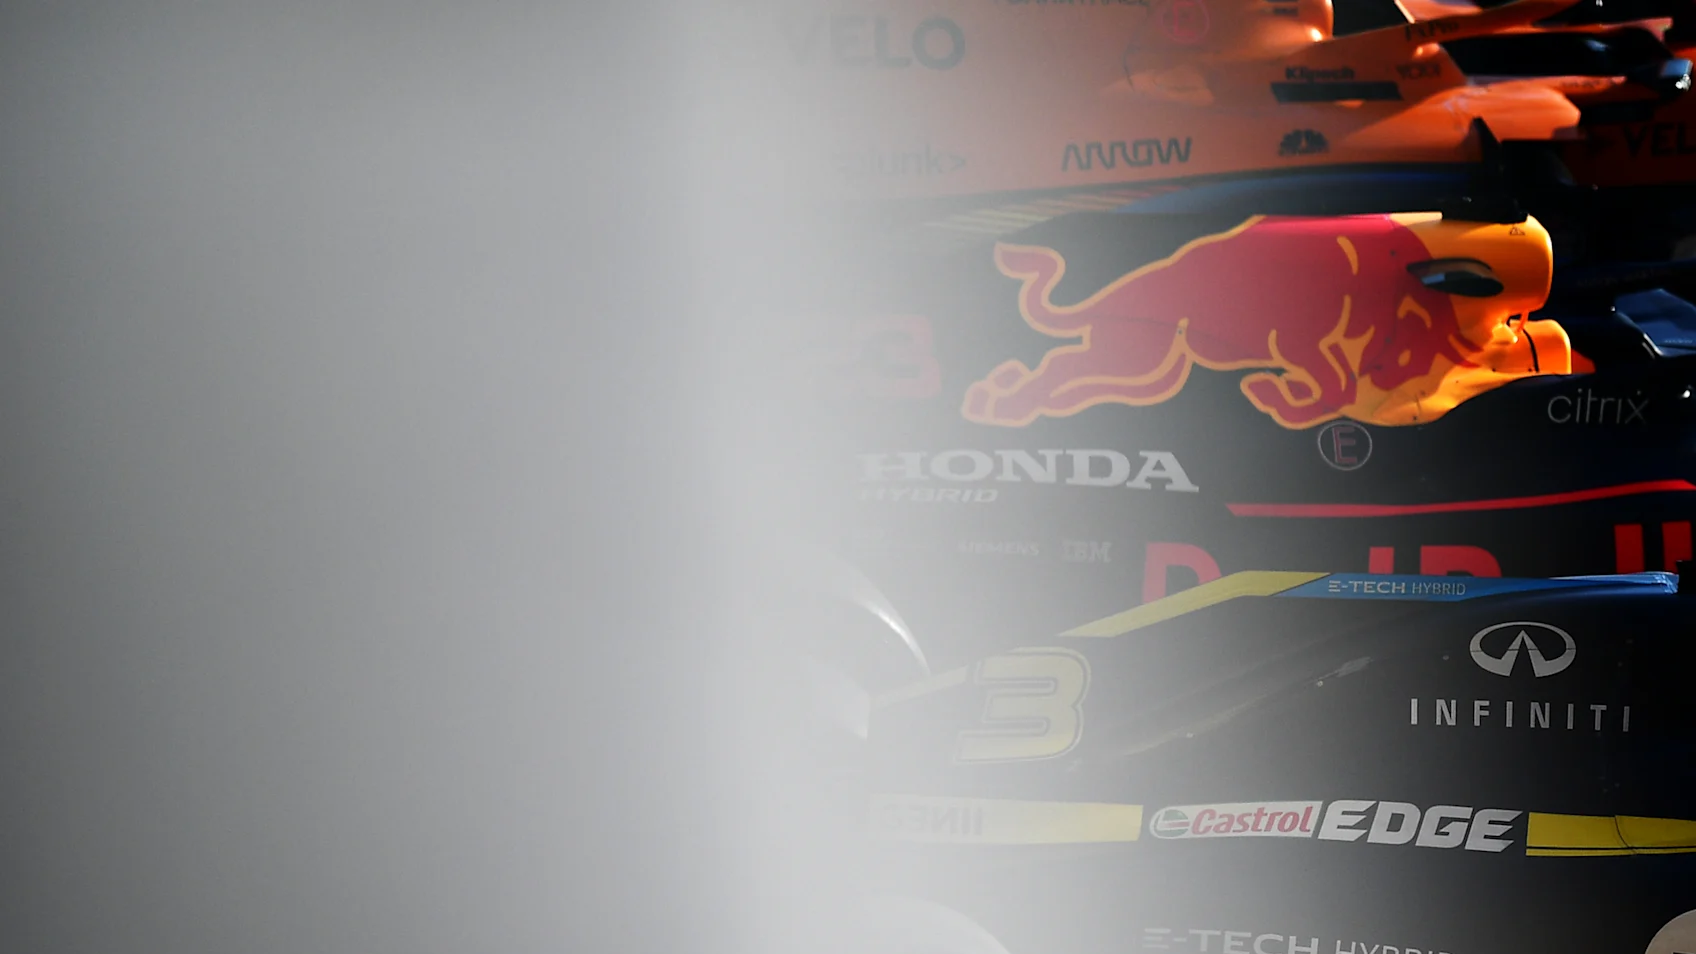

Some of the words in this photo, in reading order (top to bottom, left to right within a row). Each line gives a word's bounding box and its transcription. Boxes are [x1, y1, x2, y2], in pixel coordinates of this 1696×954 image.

[1547, 387, 1650, 424] citrix
[856, 449, 1200, 493] HONDA
[1061, 539, 1112, 564] IBM
[1328, 580, 1406, 594] E-TECH
[1412, 582, 1467, 596] HYBRID
[953, 647, 1090, 765] 3
[1410, 698, 1630, 733] INFINITI
[1192, 806, 1314, 836] Castrol
[1318, 800, 1524, 853] EDGE
